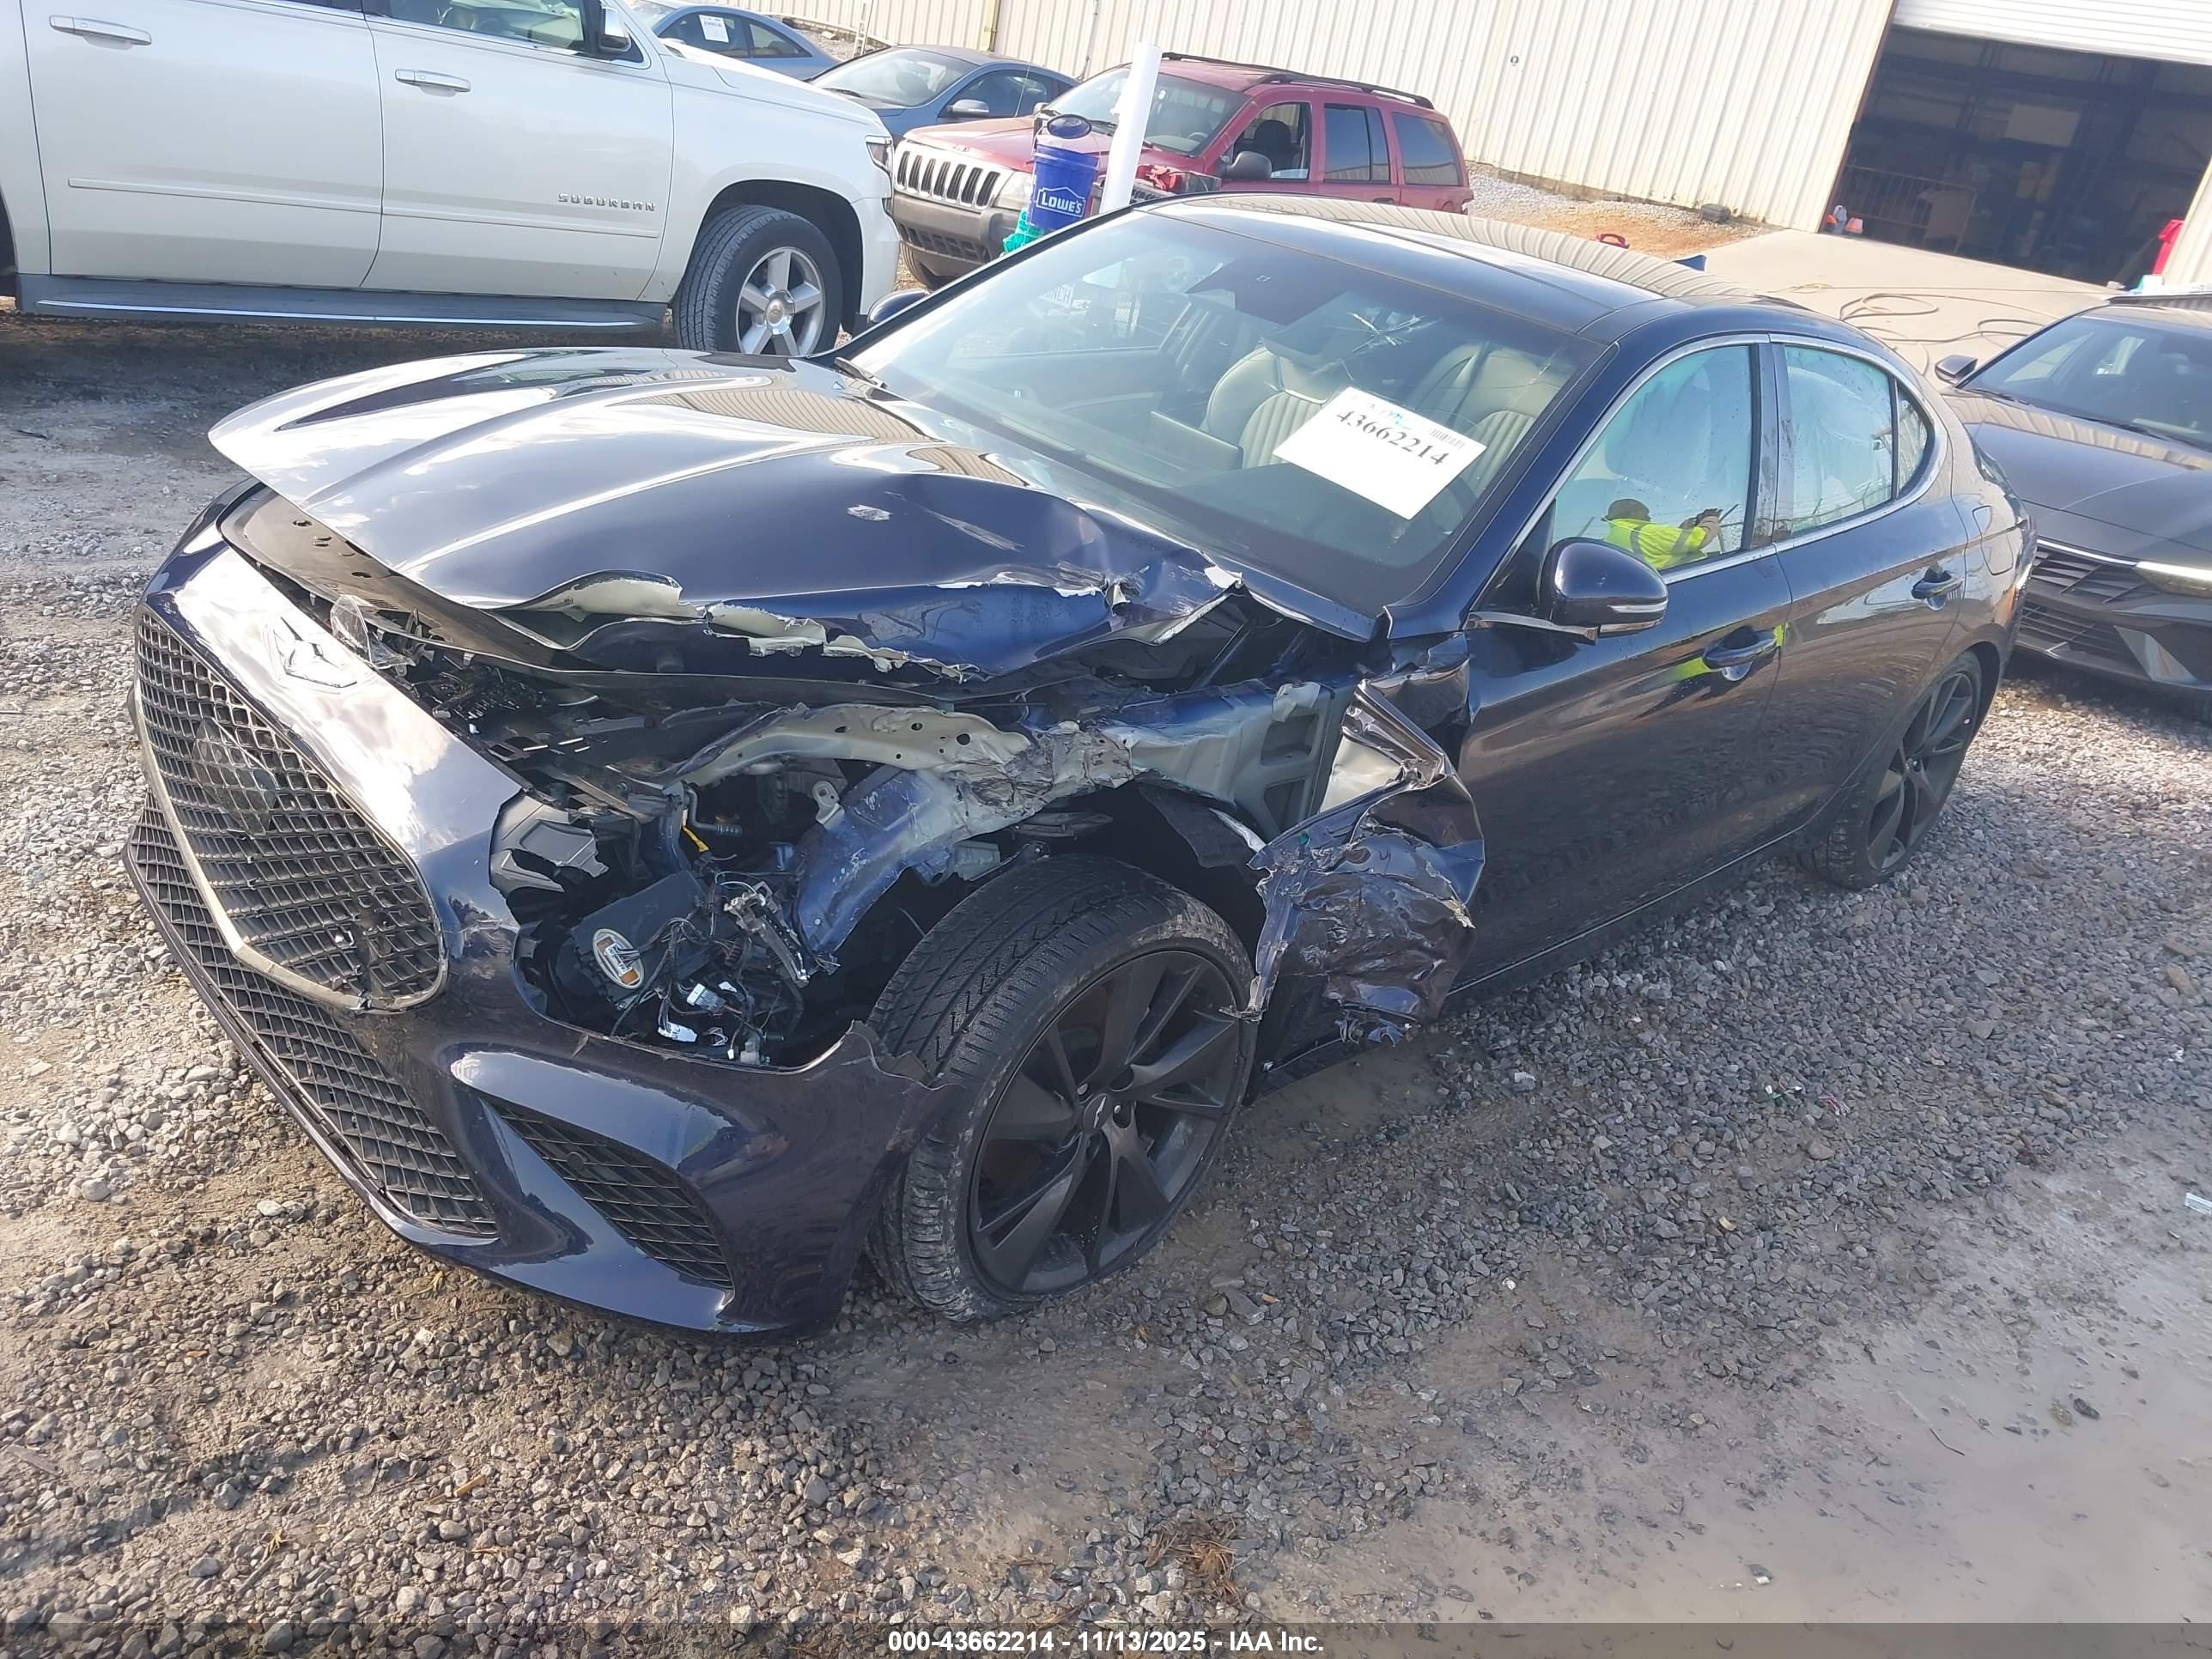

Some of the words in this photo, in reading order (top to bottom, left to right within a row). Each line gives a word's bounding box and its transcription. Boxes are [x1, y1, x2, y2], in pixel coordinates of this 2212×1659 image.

[558, 192, 655, 211] SUBURBAN
[1041, 191, 1082, 214] LOWE'S
[1336, 410, 1449, 465] 43662214
